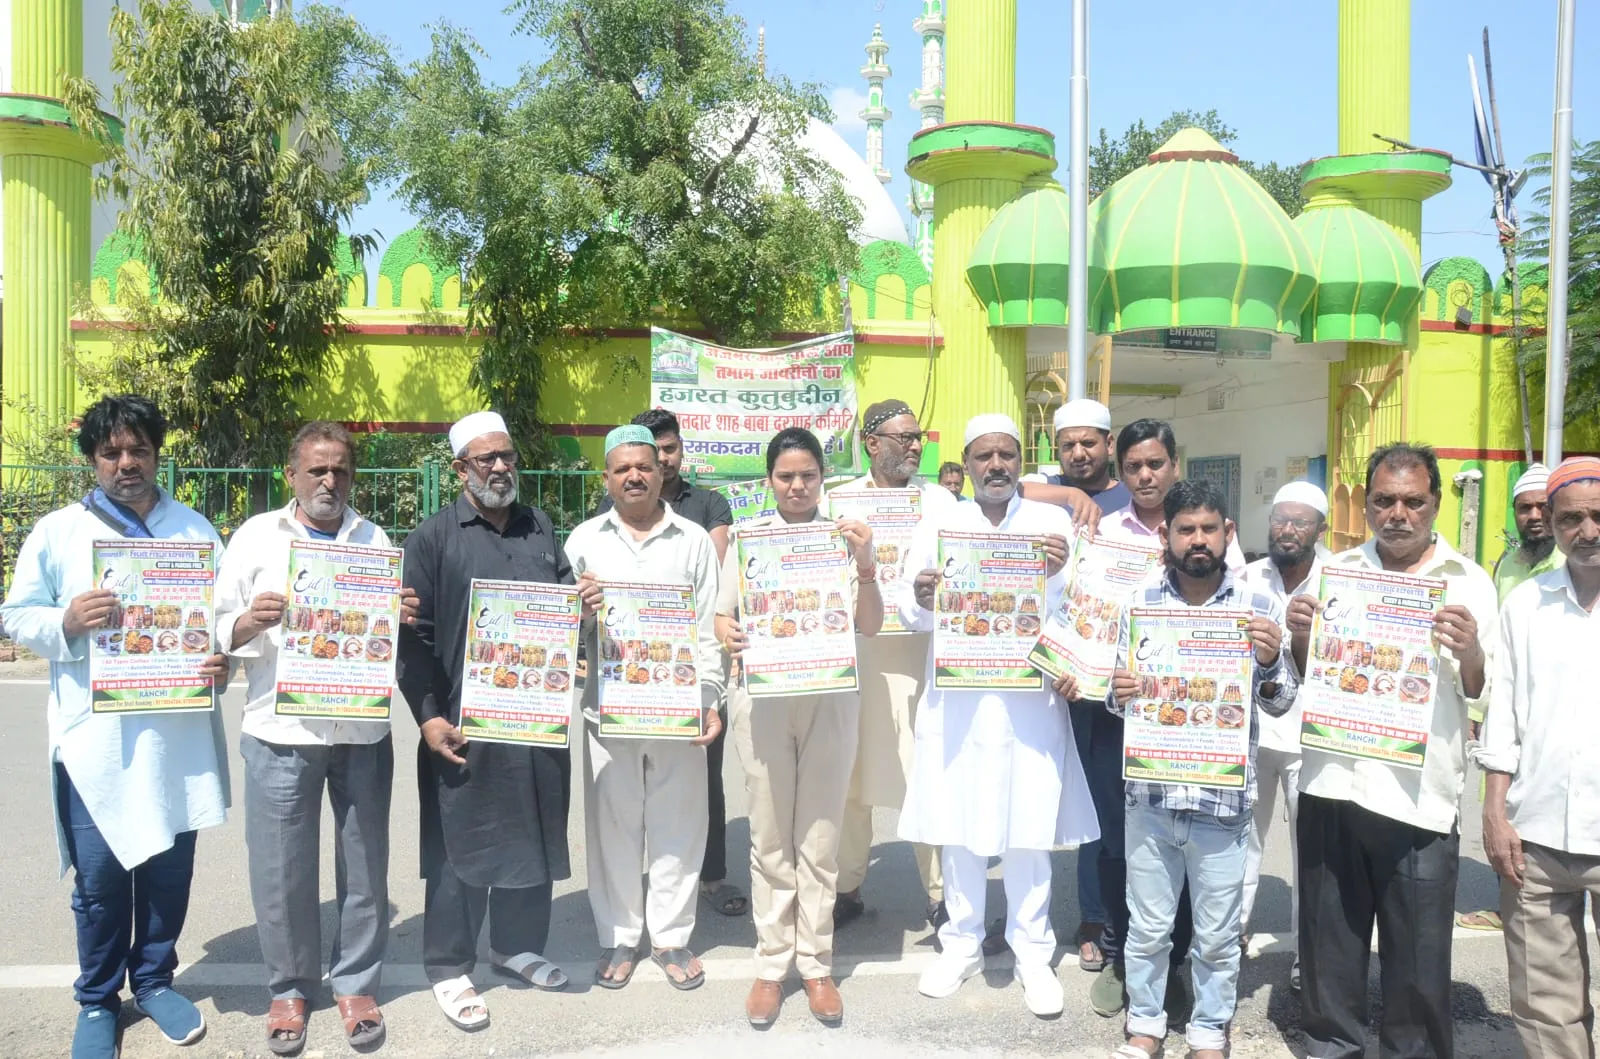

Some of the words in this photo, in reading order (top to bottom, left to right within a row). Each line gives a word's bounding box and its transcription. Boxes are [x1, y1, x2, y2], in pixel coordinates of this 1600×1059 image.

[1169, 327, 1216, 338] ENTRANCE
[716, 366, 754, 379] तमाम
[823, 366, 841, 379] का
[659, 387, 728, 404] हजरत
[737, 384, 841, 411] कुतुबुद्दीन
[716, 413, 739, 432] शाह
[743, 415, 769, 432] बाबा
[942, 556, 967, 579] Eid
[293, 568, 321, 594] Eid
[945, 580, 975, 588] EXPO
[295, 594, 328, 605] EXPO
[1322, 595, 1352, 624] Eid
[477, 630, 508, 640] EXPO
[1323, 623, 1359, 636] EXPO
[1136, 636, 1163, 662] Eid
[1138, 663, 1172, 672] EXPO
[138, 689, 167, 698] RANCHI
[320, 696, 348, 704] RANCHI
[501, 721, 527, 730] RANCHI
[1346, 732, 1377, 745] RANCHI
[1170, 762, 1198, 771] RANCHI
